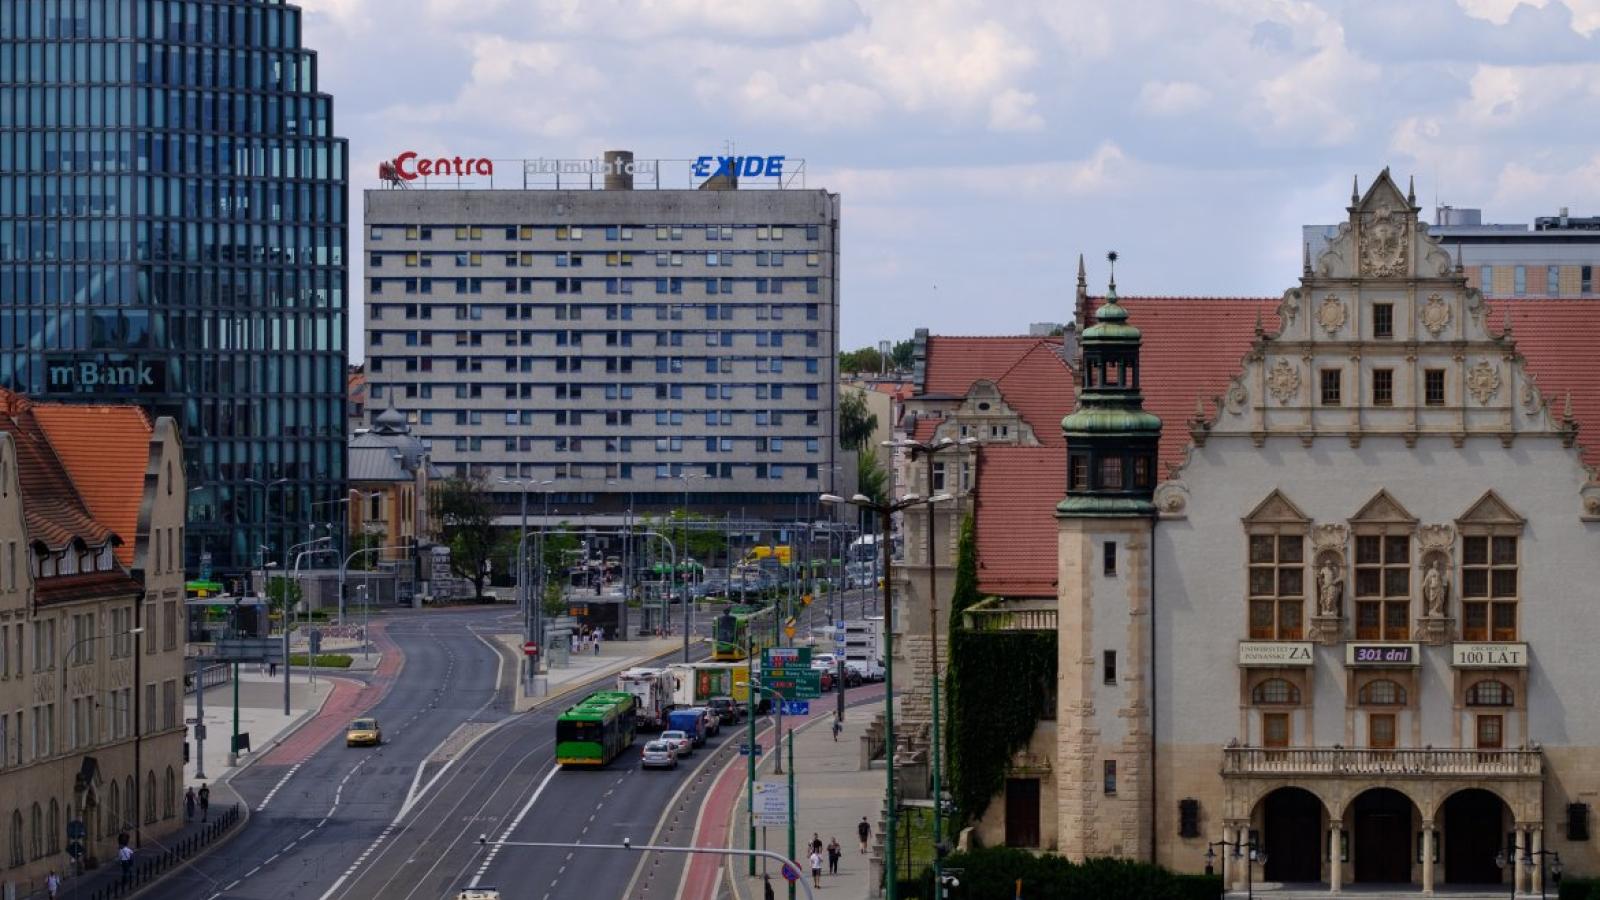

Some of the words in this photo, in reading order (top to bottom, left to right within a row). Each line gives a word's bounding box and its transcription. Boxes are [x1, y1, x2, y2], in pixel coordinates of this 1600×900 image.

[394, 151, 493, 180] Centra
[525, 156, 657, 181] akumulatory
[691, 155, 785, 177] EXIDE
[50, 360, 154, 385] mBank
[1289, 647, 1311, 659] ZA
[1357, 648, 1382, 661] 301
[1386, 648, 1408, 661] dni
[1459, 651, 1483, 663] 100
[1488, 651, 1520, 663] LAT
